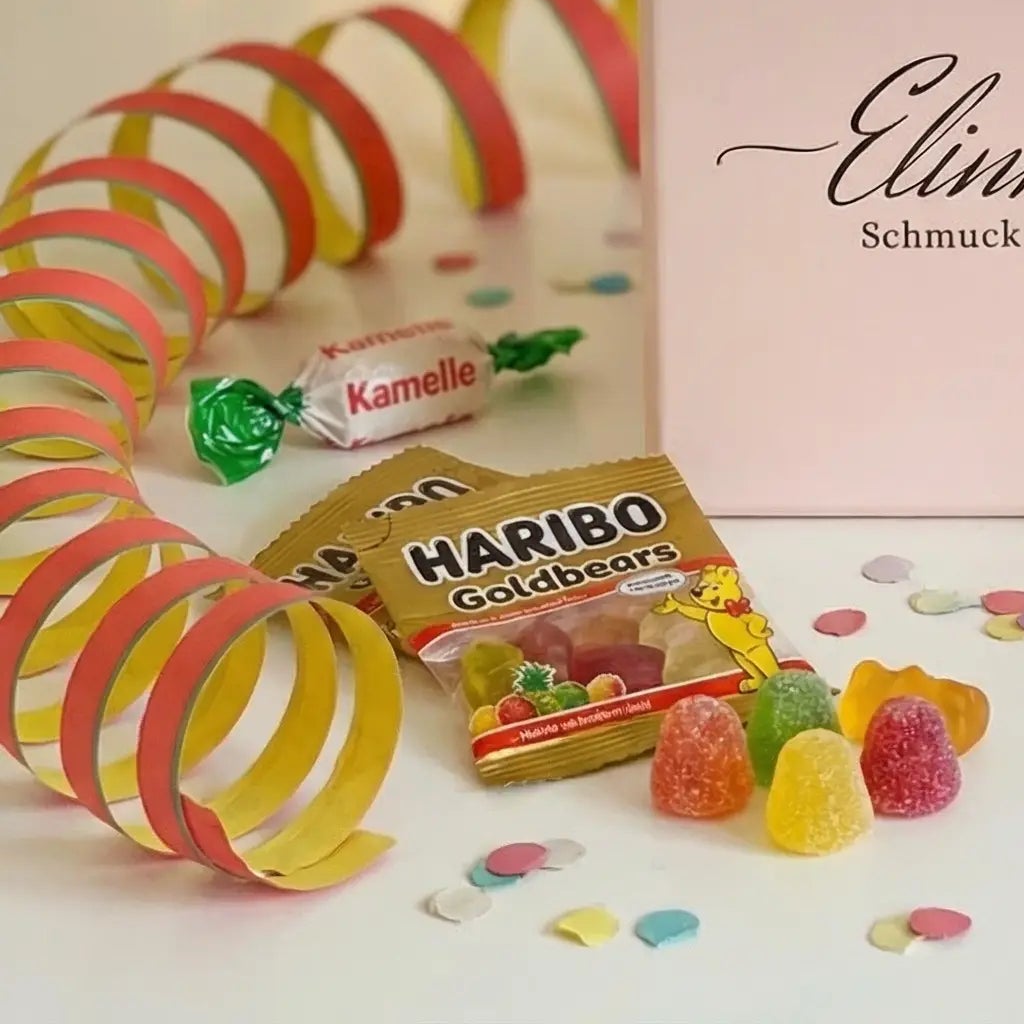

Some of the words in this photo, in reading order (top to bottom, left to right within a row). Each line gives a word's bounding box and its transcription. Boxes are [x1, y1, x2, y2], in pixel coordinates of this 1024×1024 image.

[861, 219, 1020, 249] Schmuck
[346, 356, 477, 415] Kamelle
[406, 493, 664, 583] HARIBO
[450, 542, 681, 612] Goldbears
